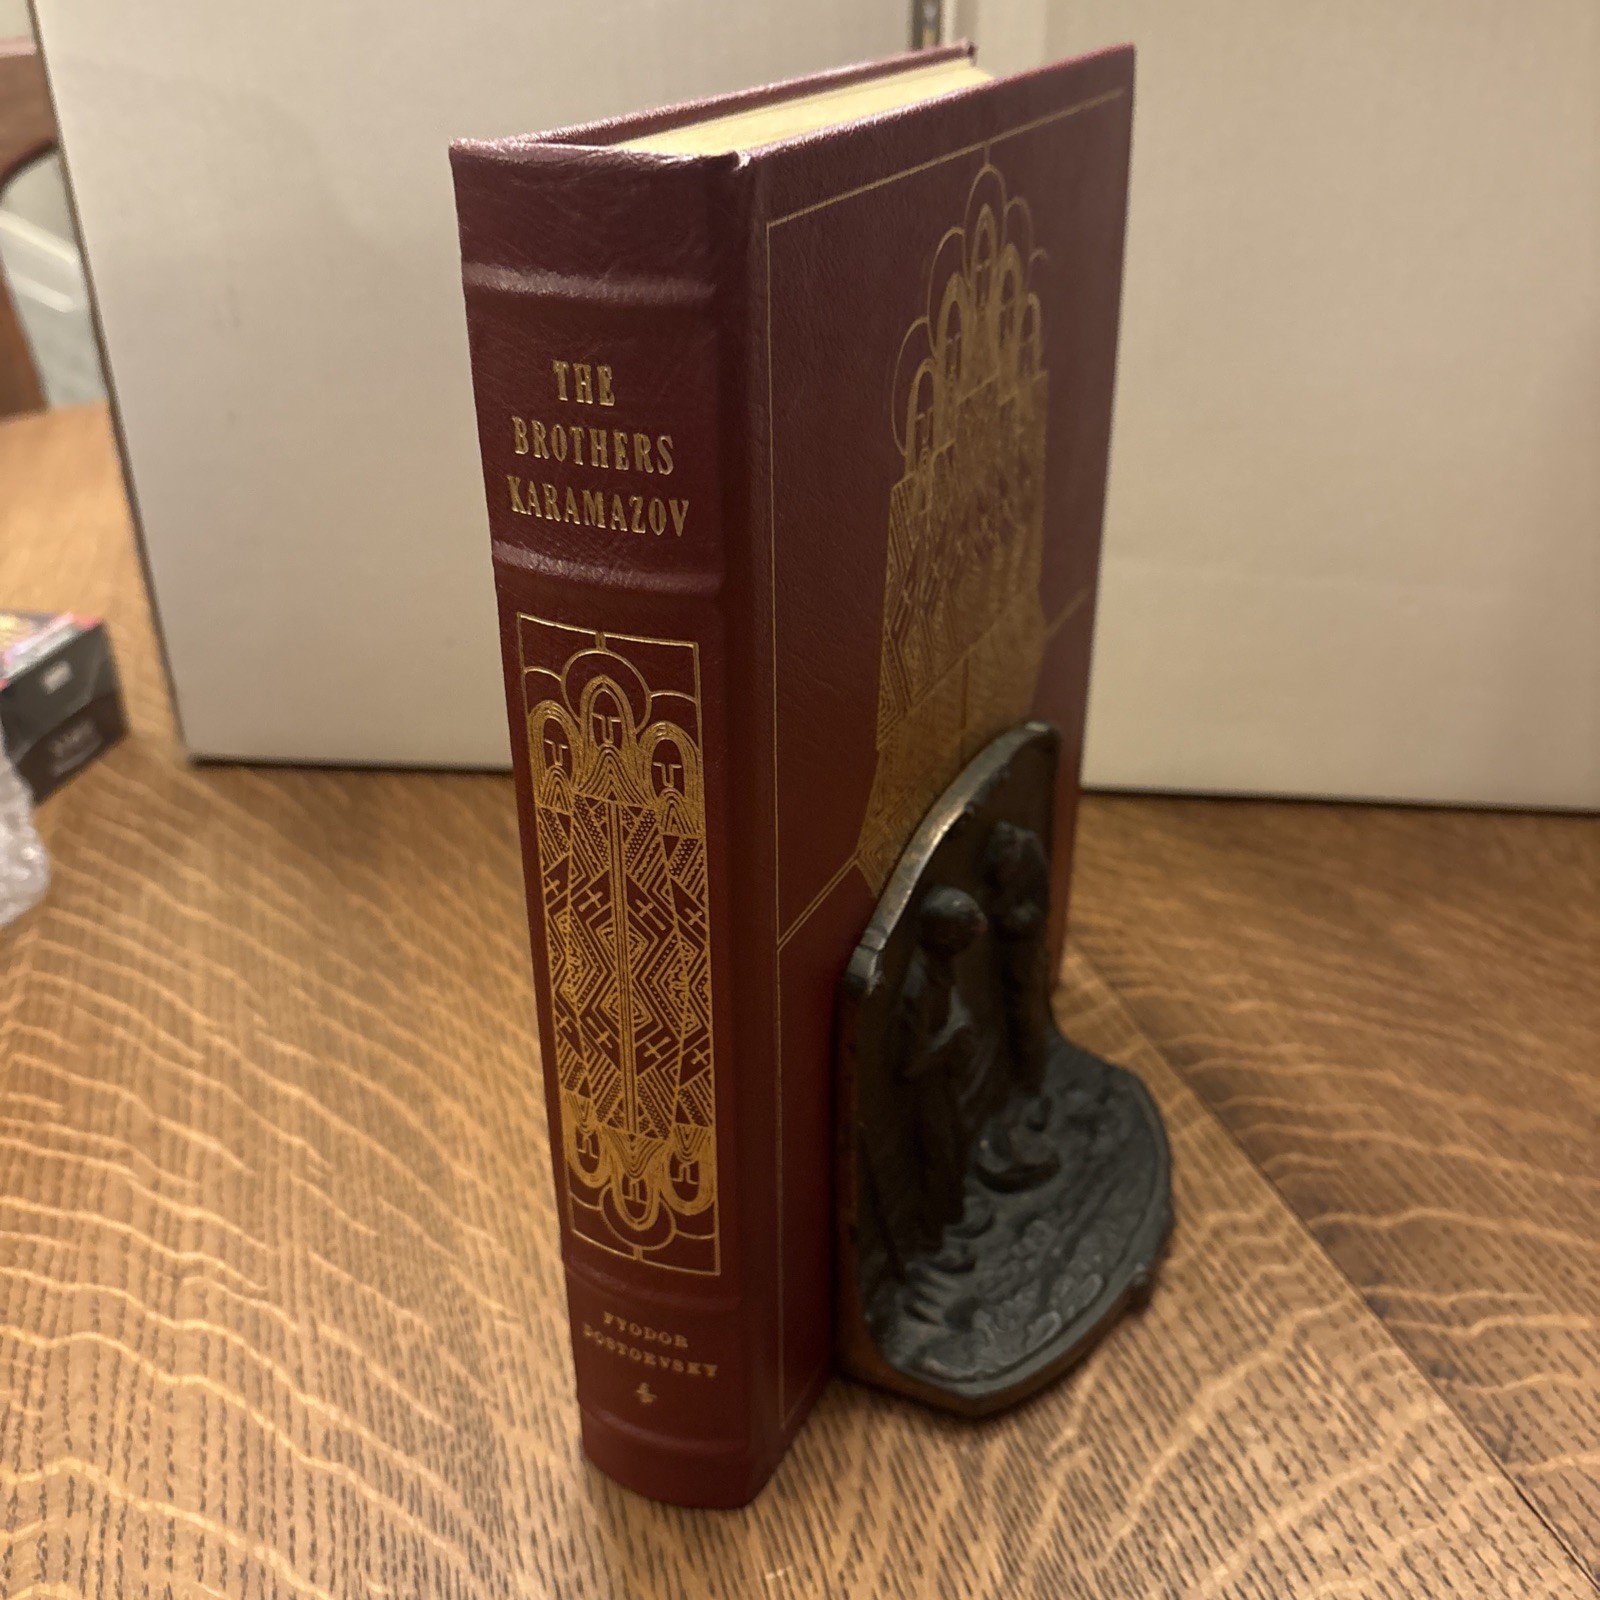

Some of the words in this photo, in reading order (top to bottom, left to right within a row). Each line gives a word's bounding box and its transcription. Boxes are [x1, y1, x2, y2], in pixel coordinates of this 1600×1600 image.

[553, 360, 615, 406] THE
[511, 415, 674, 475] BROTHERS
[506, 475, 690, 536] KARAMAZOV
[603, 1311, 688, 1348] FYODOR
